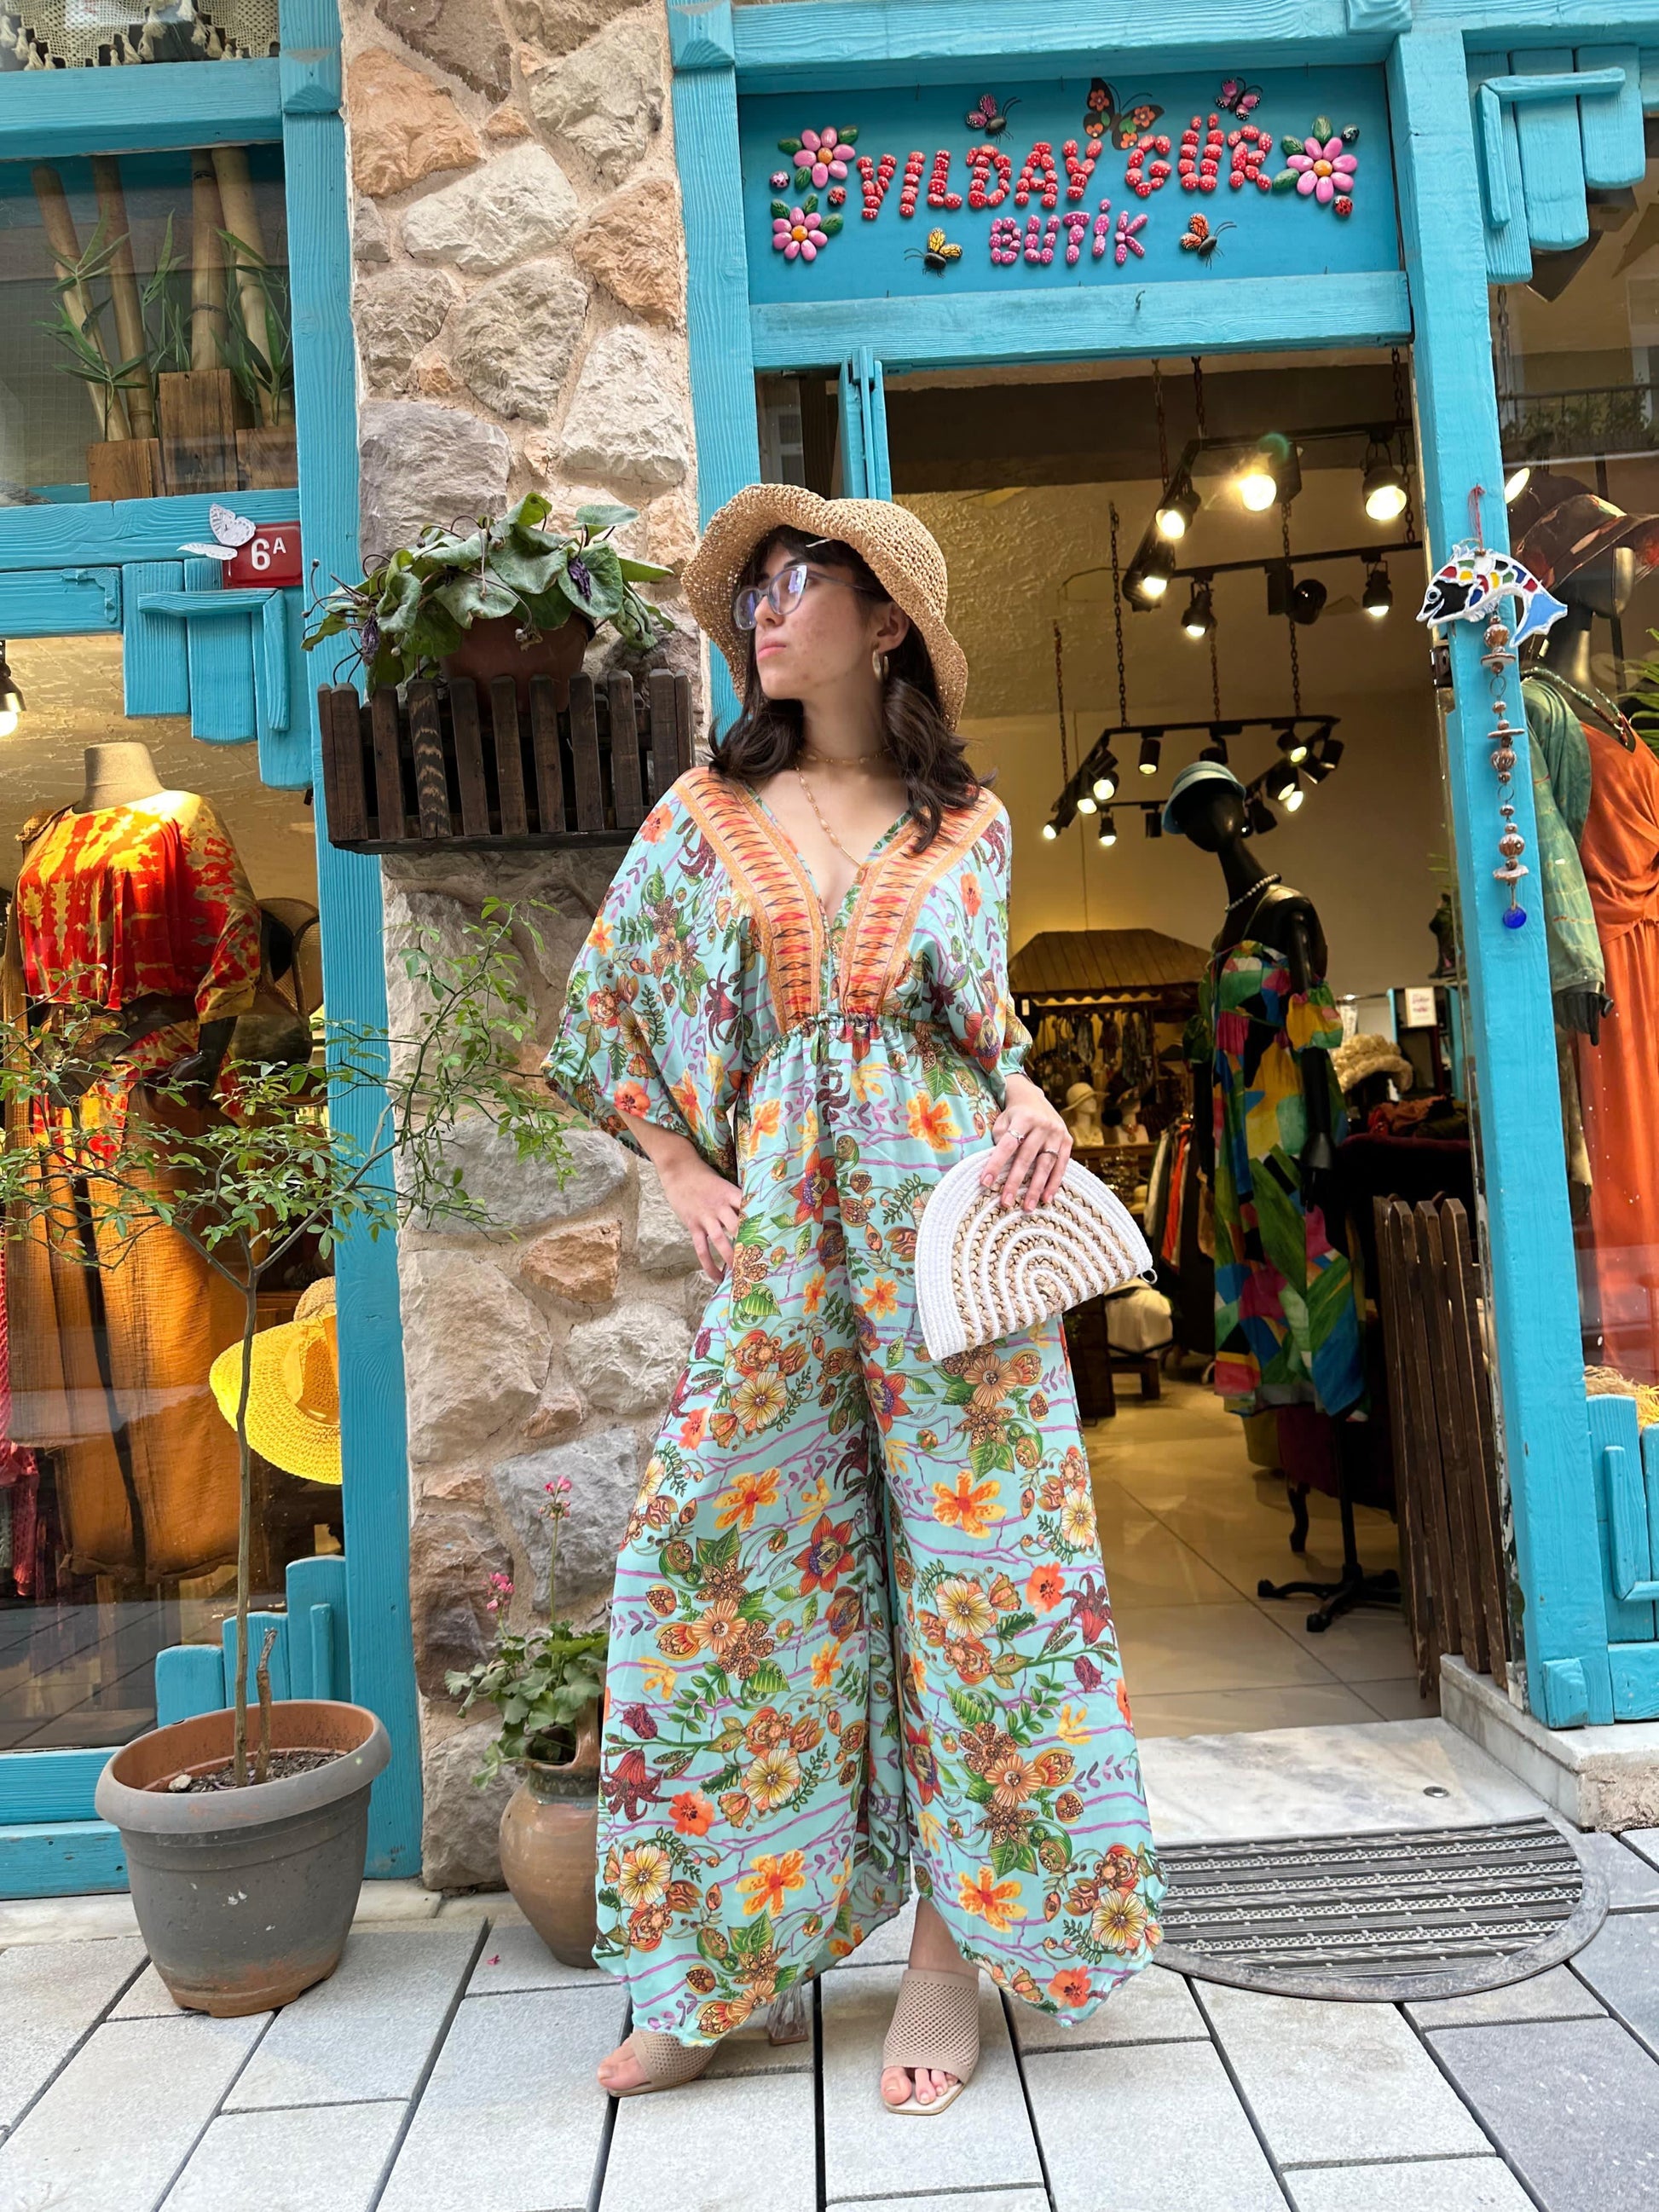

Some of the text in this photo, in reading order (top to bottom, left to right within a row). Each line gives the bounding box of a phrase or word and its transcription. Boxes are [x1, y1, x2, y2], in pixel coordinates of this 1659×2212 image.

[1125, 113, 1272, 198] GÜR
[989, 199, 1148, 264] BUTİK
[251, 537, 286, 570] 6A
